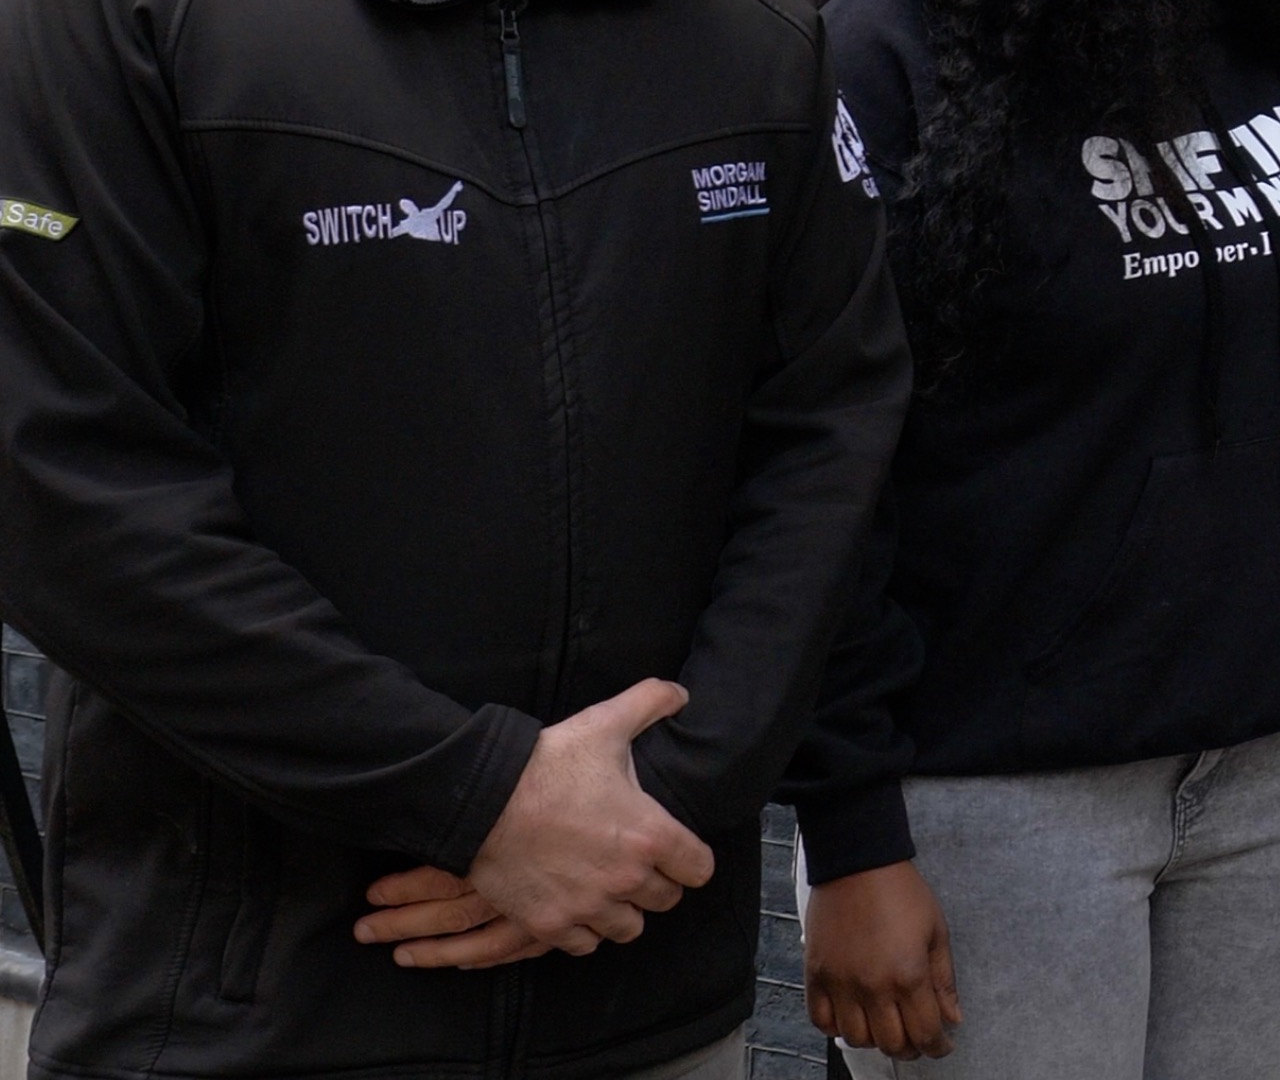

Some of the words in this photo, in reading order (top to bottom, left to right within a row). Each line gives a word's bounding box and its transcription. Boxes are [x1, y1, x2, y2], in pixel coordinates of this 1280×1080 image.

[691, 162, 766, 189] MORGAN
[697, 184, 767, 212] SINDALL
[6, 203, 63, 236] Safe
[303, 203, 393, 246] SWITCH
[439, 209, 467, 245] UP
